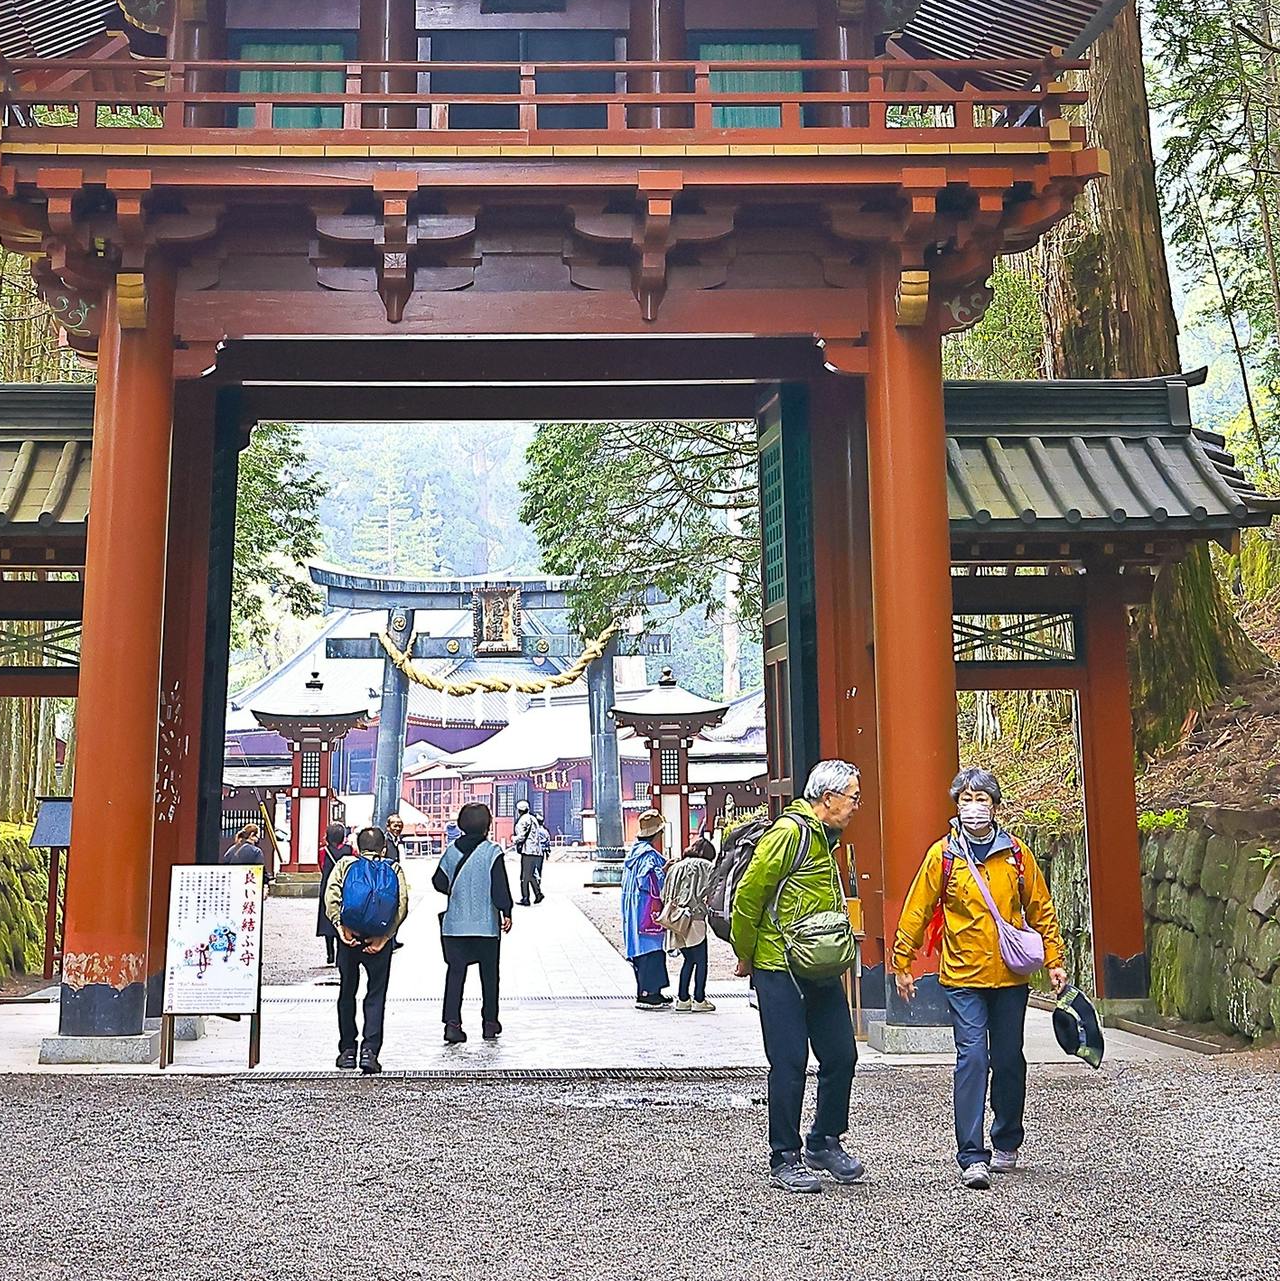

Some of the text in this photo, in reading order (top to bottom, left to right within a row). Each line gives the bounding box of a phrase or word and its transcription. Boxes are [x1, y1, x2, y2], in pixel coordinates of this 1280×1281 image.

[239, 870, 257, 967] 良い縁結ぶ守
